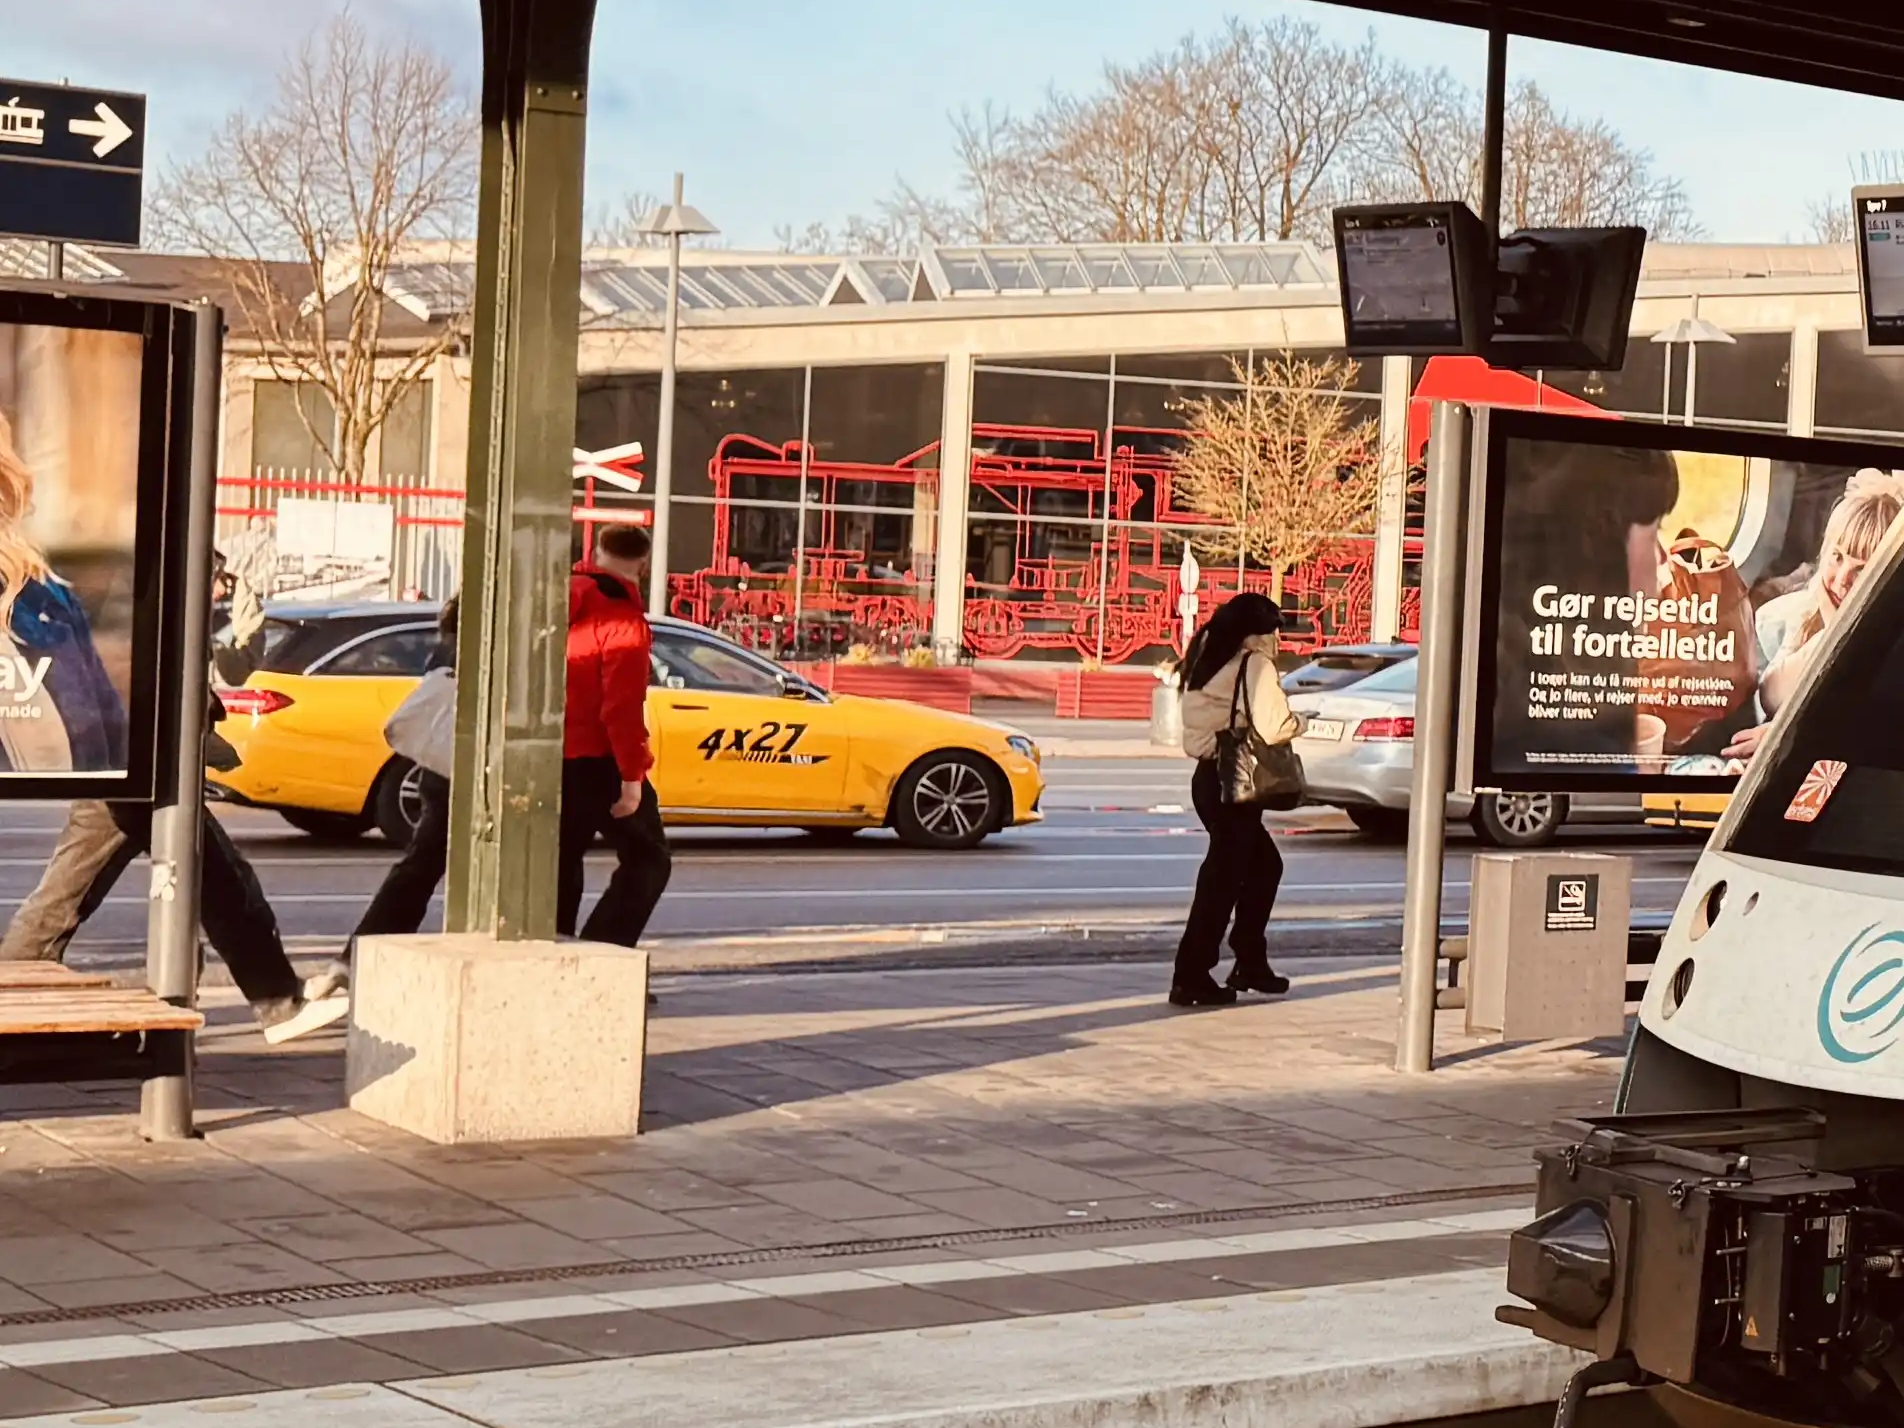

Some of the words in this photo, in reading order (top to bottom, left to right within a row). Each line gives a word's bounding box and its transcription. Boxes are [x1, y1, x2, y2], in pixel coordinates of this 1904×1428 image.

[1532, 585, 1596, 619] Gør
[1603, 590, 1719, 628] rejsetid
[1530, 622, 1564, 656] til
[1572, 624, 1736, 663] fortælletid
[1530, 671, 1535, 685] I
[1570, 672, 1590, 686] kan
[1592, 673, 1607, 687] du
[1622, 676, 1650, 688] mere
[1651, 675, 1666, 689] ud
[1667, 675, 1680, 689] af
[1529, 687, 1547, 703] Og
[1594, 689, 1605, 703] vi
[1606, 689, 1636, 706] rejser
[1528, 704, 1560, 719] bliver
